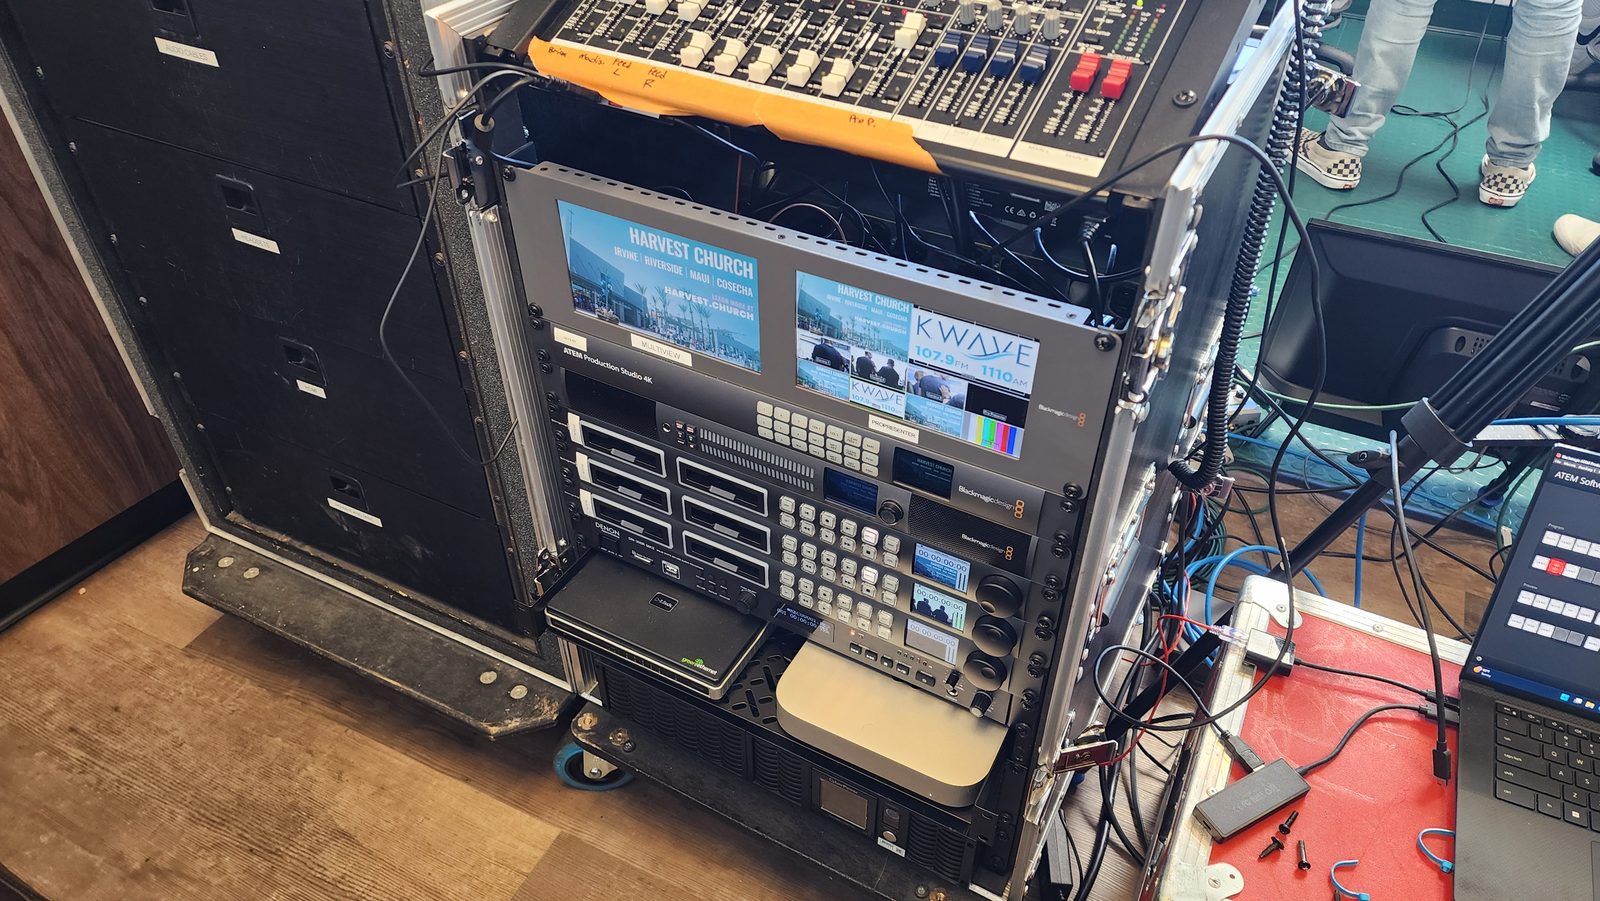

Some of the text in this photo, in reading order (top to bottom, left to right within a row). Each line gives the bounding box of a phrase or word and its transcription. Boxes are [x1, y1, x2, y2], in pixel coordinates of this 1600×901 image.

[628, 226, 754, 280] HARVEST CHURCH
[614, 246, 753, 297] IRVINE RIVERSIDE MAUI COSECHA
[664, 286, 754, 321] HARVEST.CHURCH
[838, 284, 909, 314] HARVEST CHURCH
[641, 340, 681, 360] MULTIVIEW
[916, 314, 1034, 368] KWAVE
[564, 347, 653, 384] ATEM Production Studio 4K
[871, 420, 916, 438] PROPRESENTER
[1554, 471, 1579, 483] ATEM
[958, 485, 1014, 510] Blackmagicdesign
[595, 522, 620, 536] DENON
